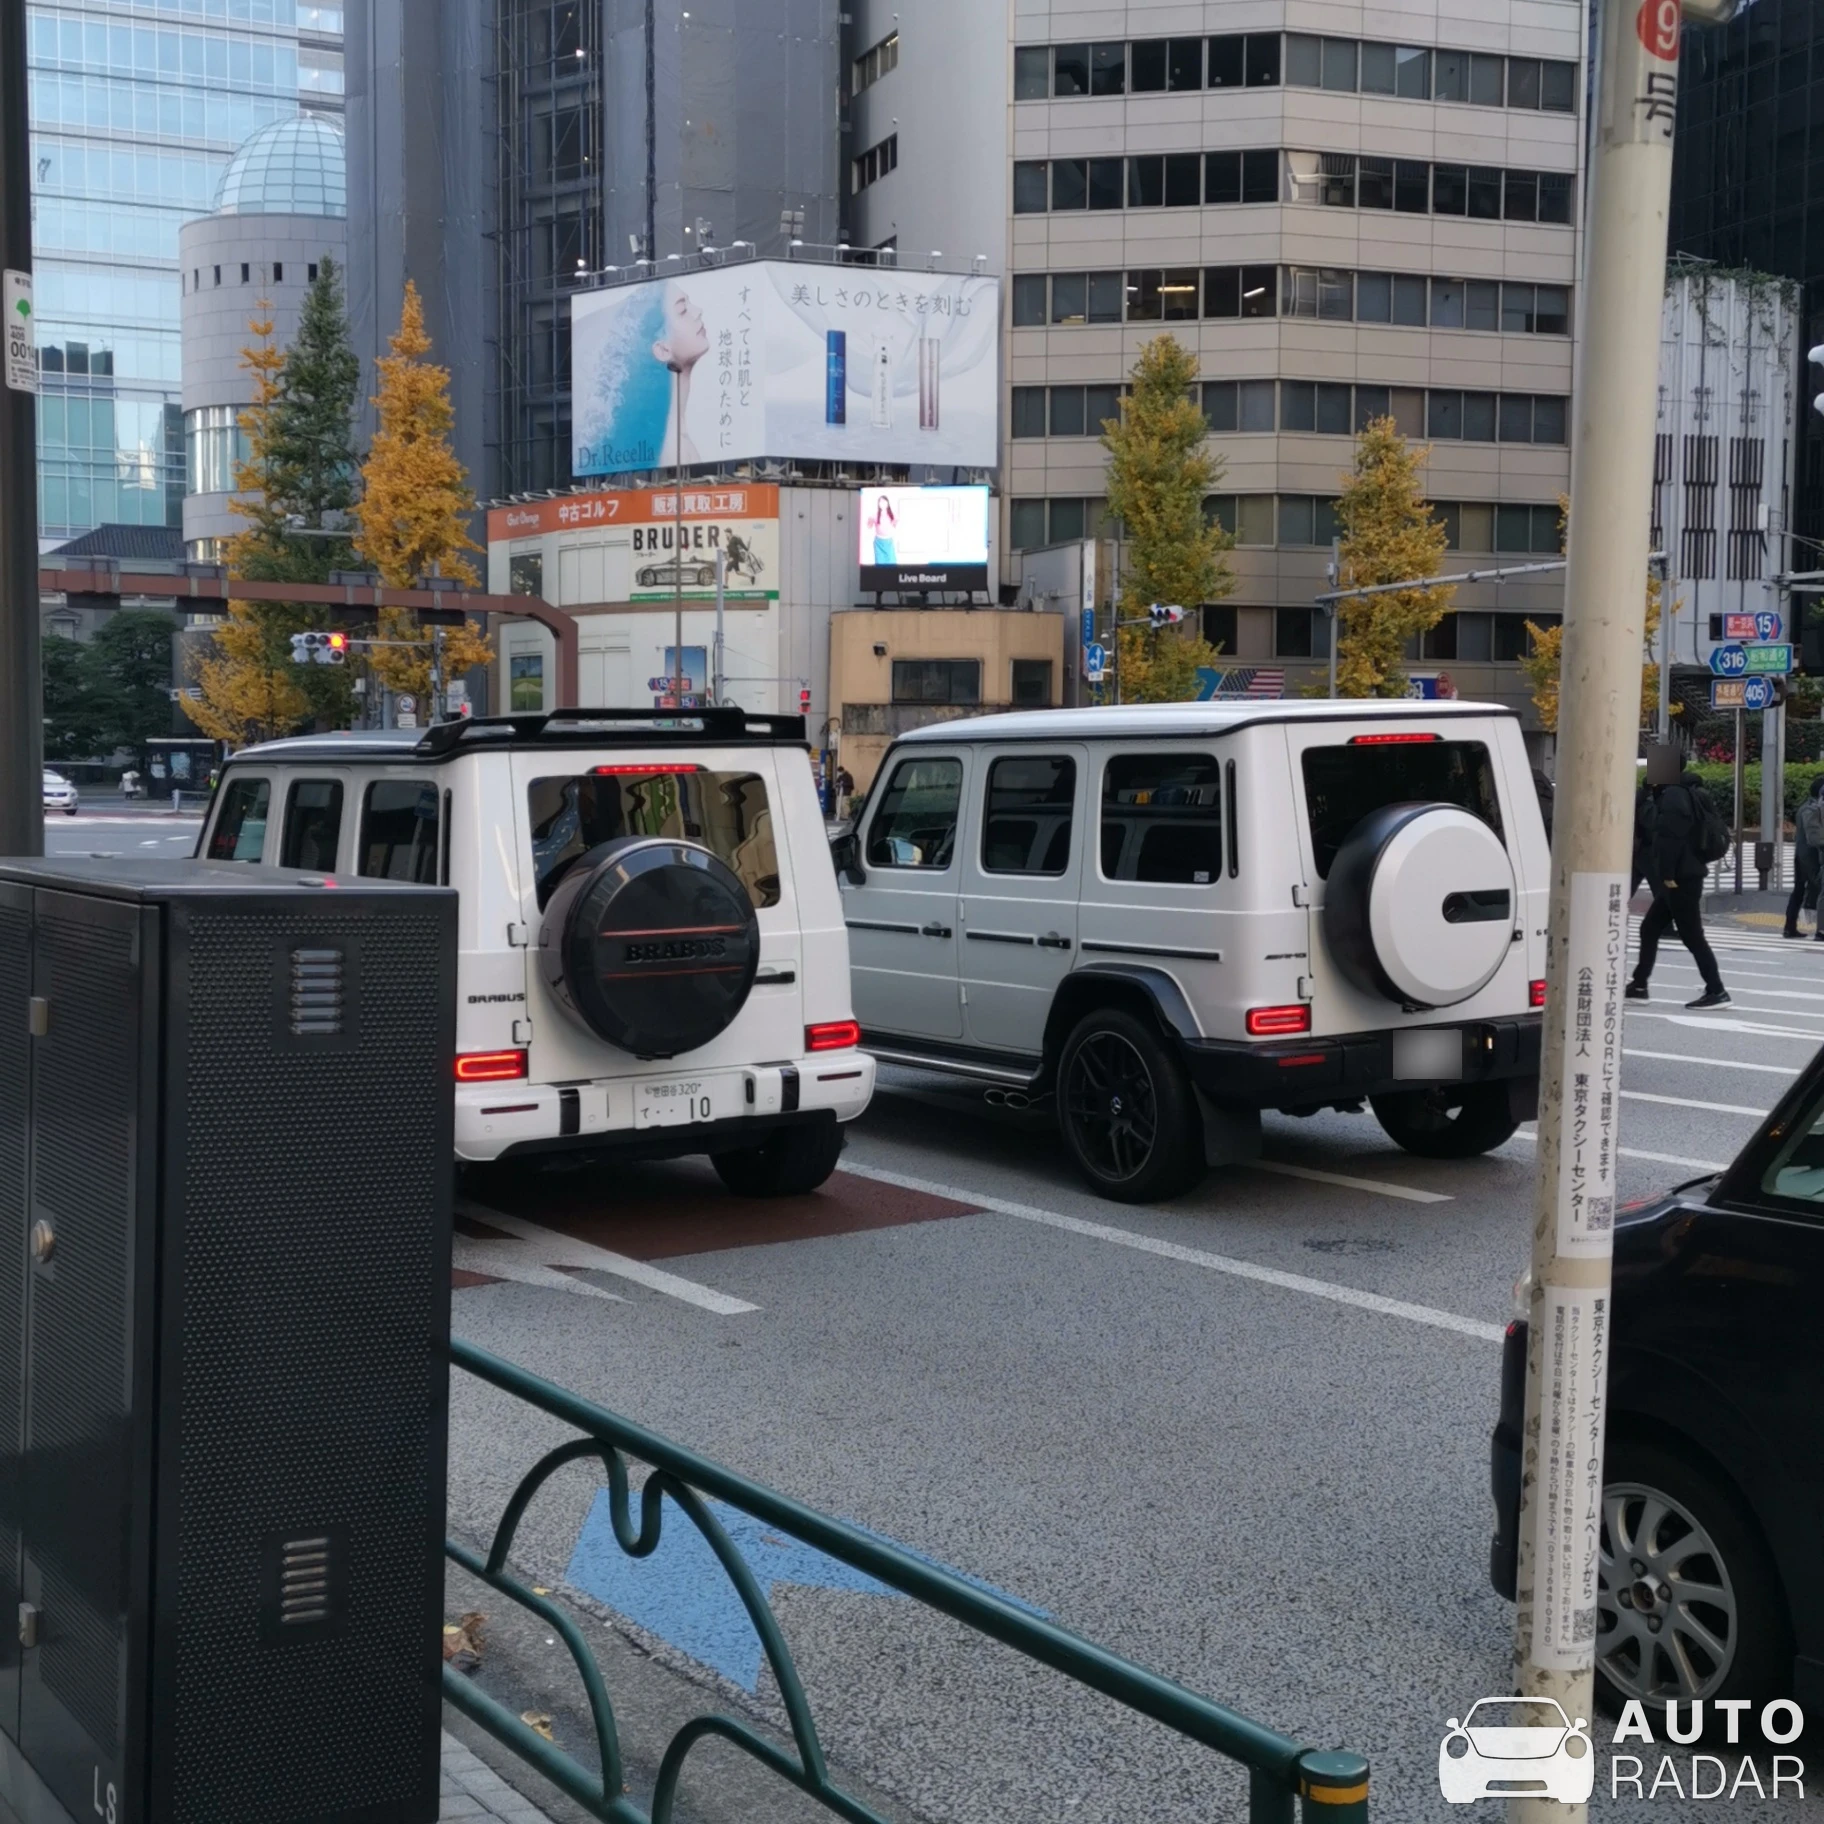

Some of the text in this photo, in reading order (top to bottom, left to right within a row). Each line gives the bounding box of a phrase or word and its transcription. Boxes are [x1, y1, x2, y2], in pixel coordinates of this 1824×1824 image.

[1657, 0, 1678, 50] 9
[791, 284, 973, 317] 美しさのときを刻む
[738, 286, 752, 407] すべては肌と
[718, 329, 733, 448] 地球のために
[578, 439, 656, 469] Dr.Recella
[558, 500, 620, 524] 中古ゴルフ
[633, 525, 720, 551] BRUDER
[898, 573, 947, 583] Live Board
[1757, 615, 1772, 633] 15
[1722, 651, 1745, 669] 316
[1745, 684, 1764, 701] 405
[468, 993, 525, 1004] BRABUS
[1575, 966, 1594, 1058] 公益財団法人
[1571, 1073, 1590, 1222] 東京タクシーセンター
